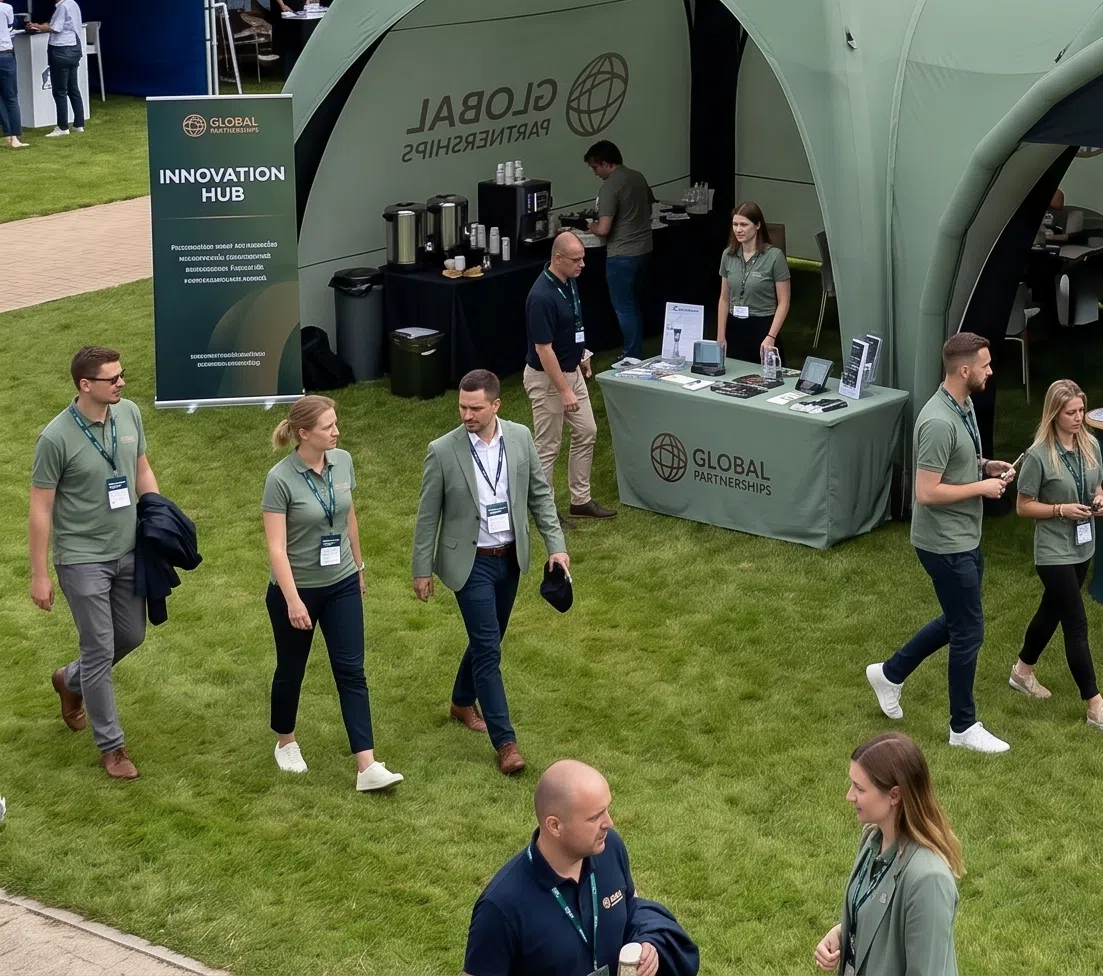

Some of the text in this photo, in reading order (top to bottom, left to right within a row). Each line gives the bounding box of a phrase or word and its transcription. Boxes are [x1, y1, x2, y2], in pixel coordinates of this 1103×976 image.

[210, 116, 259, 128] GLOBAL
[160, 166, 285, 184] INNOVATION
[202, 186, 245, 203] HUB
[692, 448, 771, 482] GLOBAL
[693, 470, 772, 496] PARTNERSHIPS
